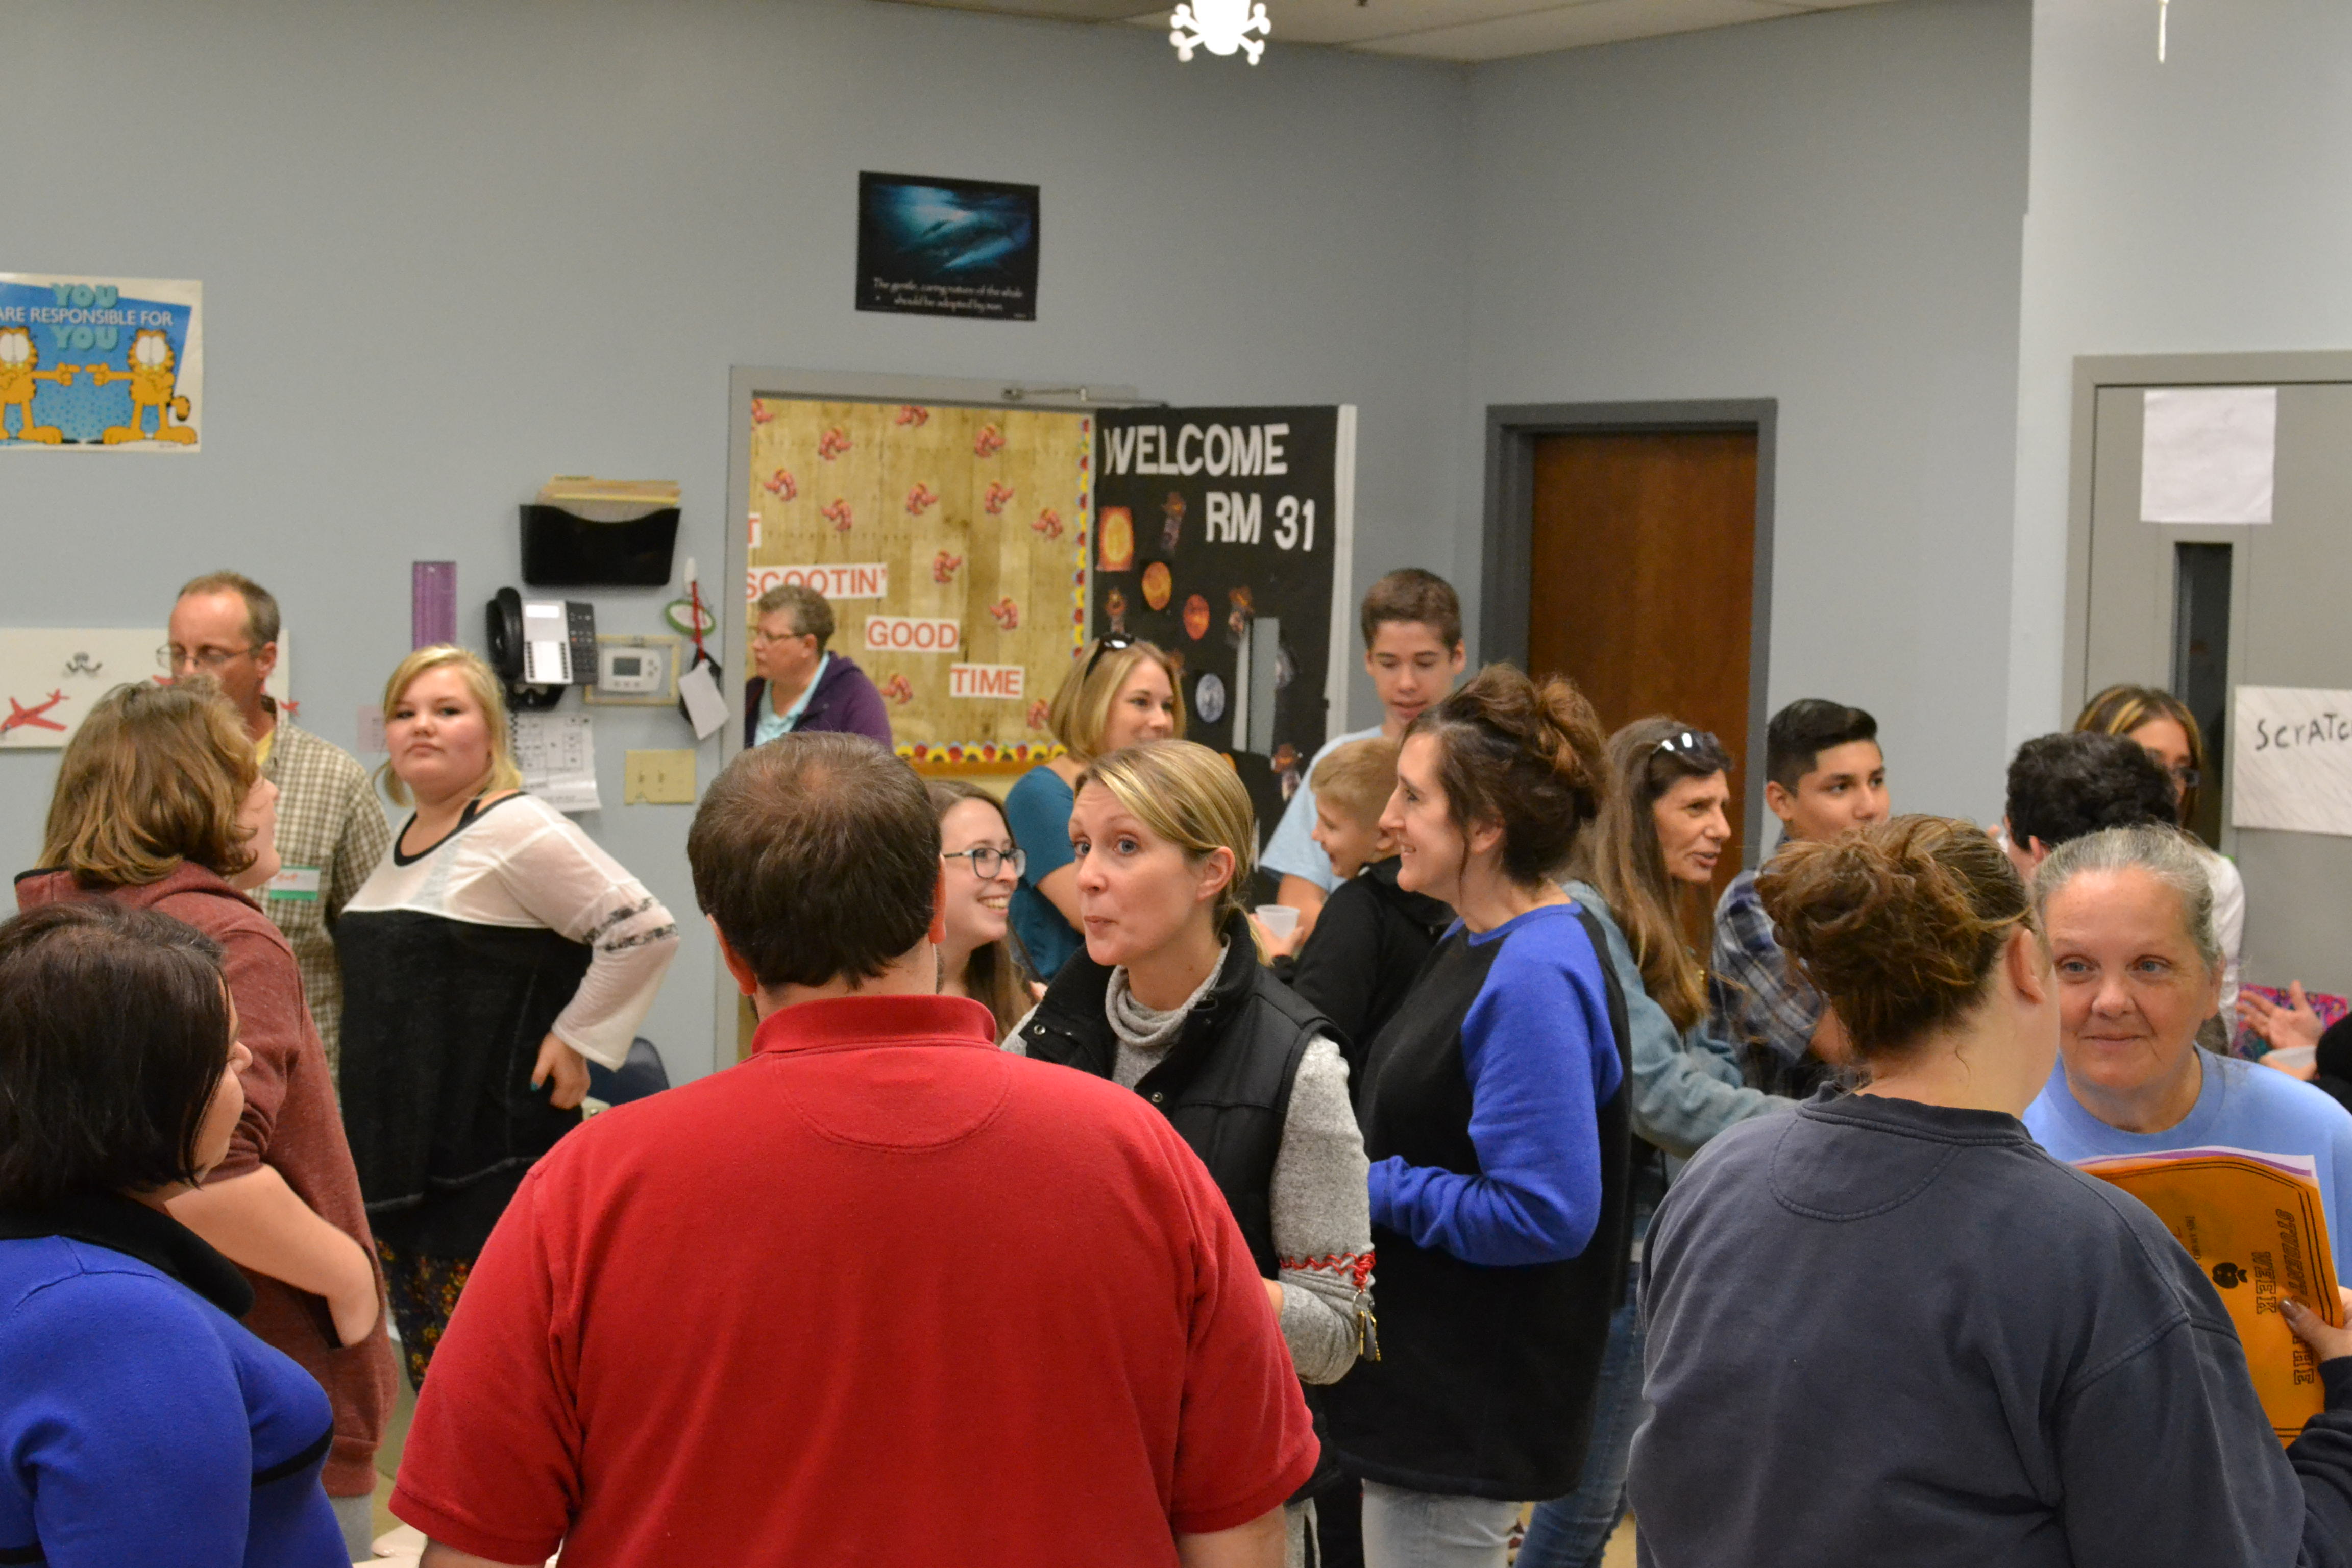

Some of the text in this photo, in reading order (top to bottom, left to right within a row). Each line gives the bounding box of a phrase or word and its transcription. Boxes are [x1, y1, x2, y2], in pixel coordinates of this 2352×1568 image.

[50, 282, 119, 309] YOU
[30, 307, 136, 326] RESPONSIBLE
[141, 310, 174, 326] FOR
[50, 325, 119, 352] YOU
[1104, 423, 1290, 476] WELCOME
[1205, 491, 1315, 552] RM 31
[868, 620, 959, 648] GOOD
[951, 668, 1021, 695] TIME
[2275, 1208, 2308, 1296] STUDENT
[2251, 1251, 2277, 1314] WEEK
